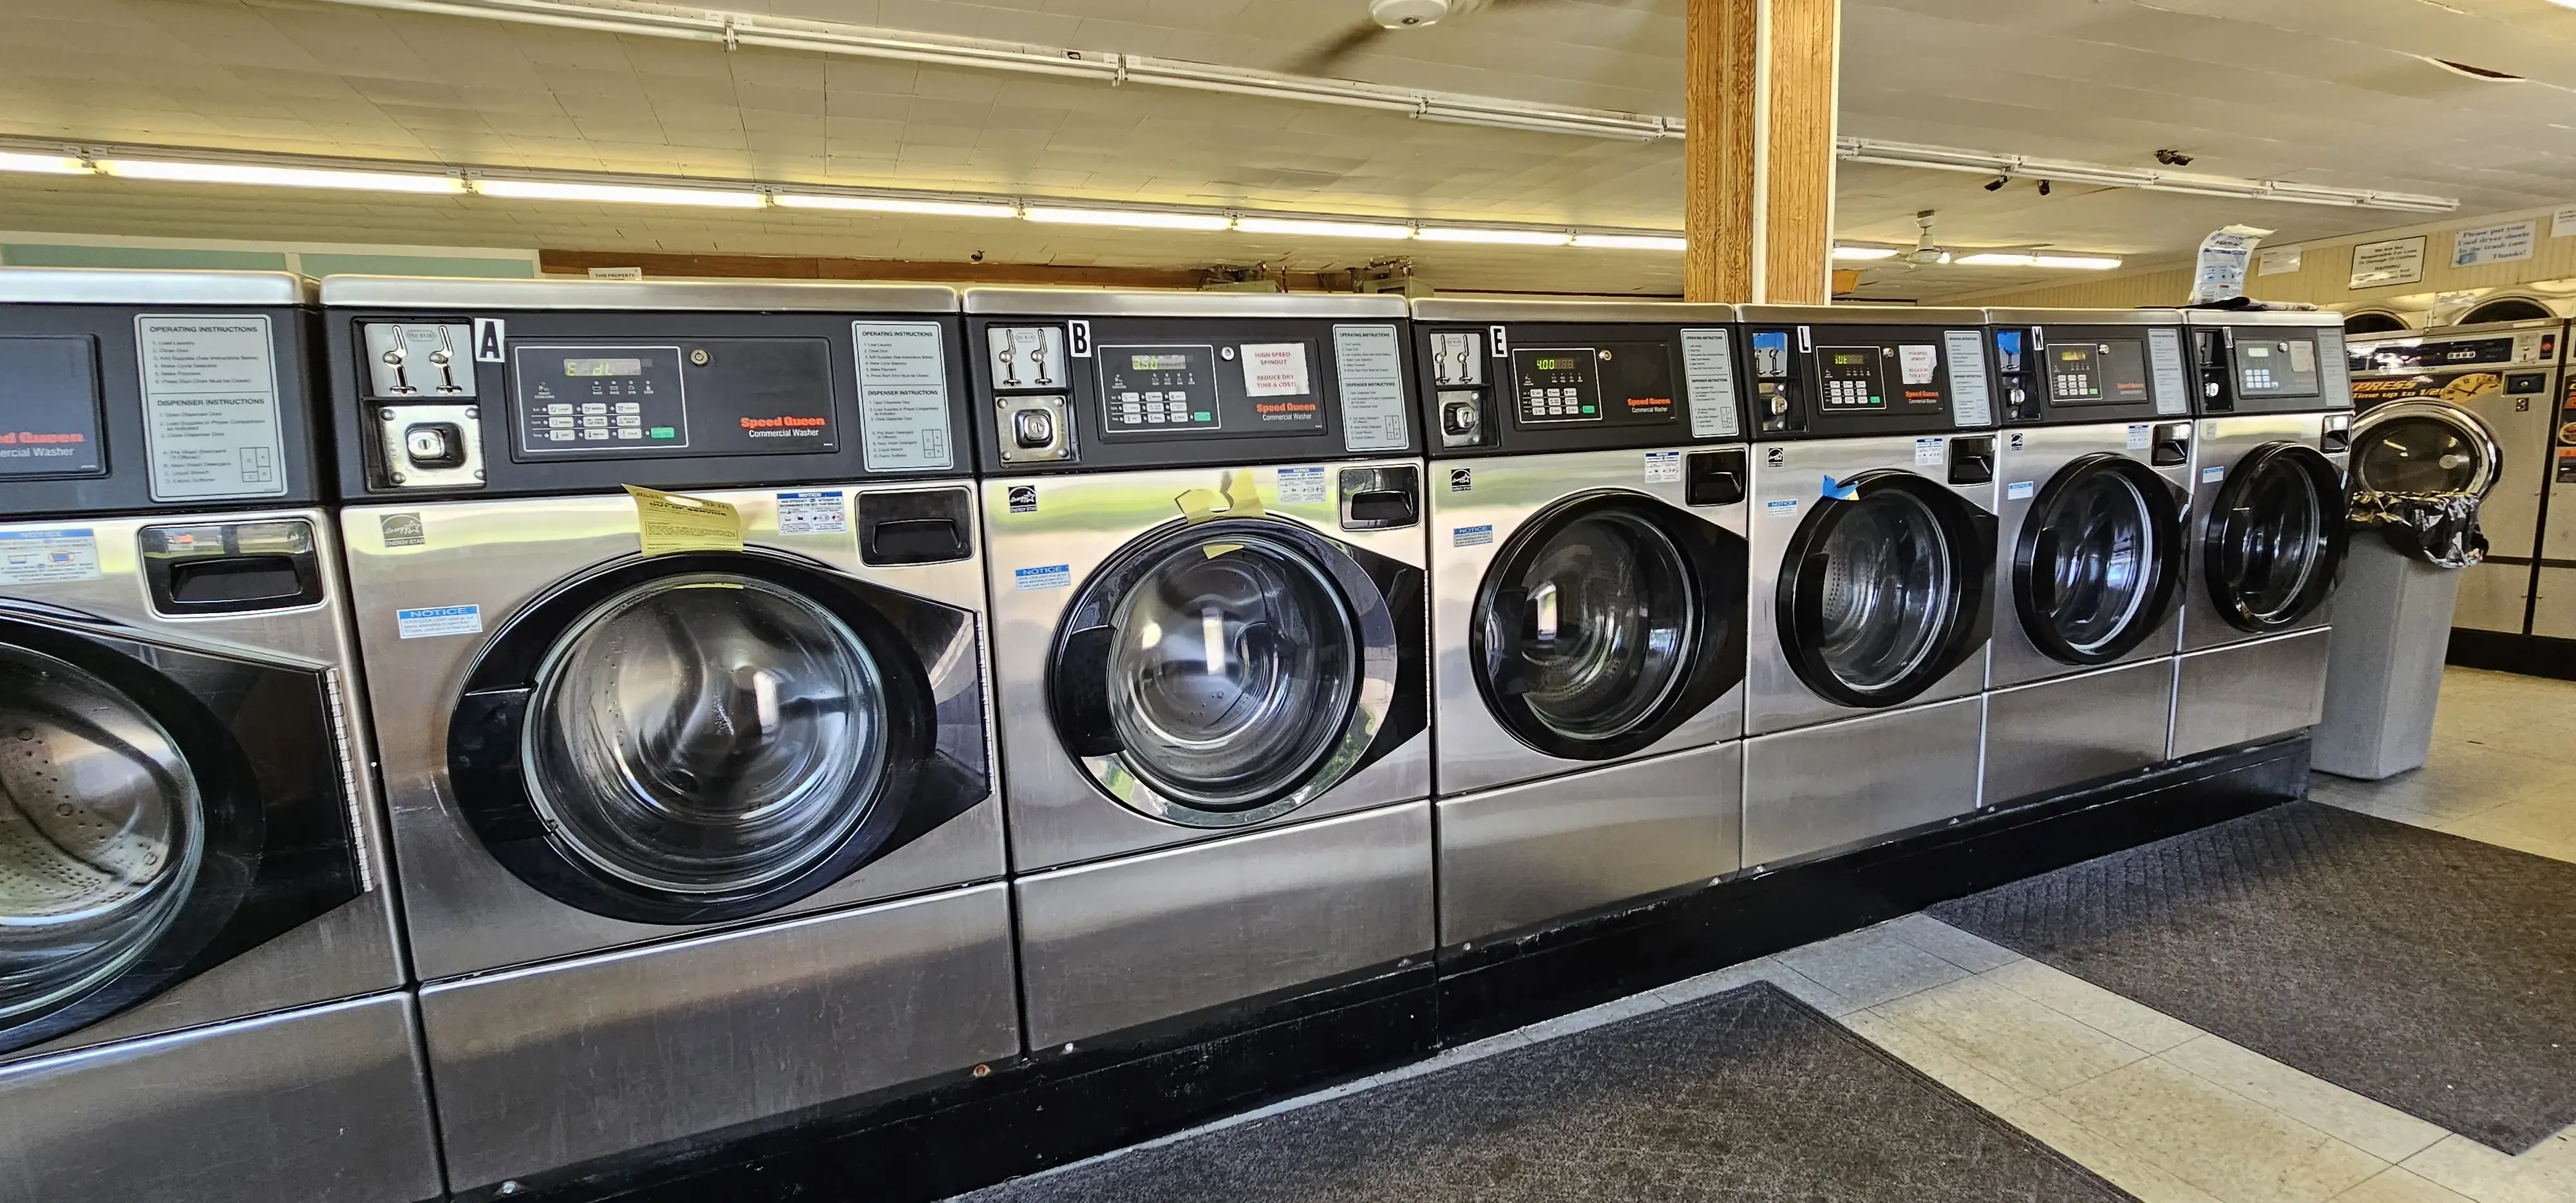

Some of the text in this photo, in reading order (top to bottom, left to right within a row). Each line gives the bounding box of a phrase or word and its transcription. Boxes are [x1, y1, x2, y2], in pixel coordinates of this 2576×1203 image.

[479, 321, 500, 359] A
[1072, 323, 1087, 354] B
[1493, 328, 1504, 355] E
[1800, 328, 1809, 350] L
[2034, 328, 2042, 348] M
[1256, 403, 1285, 413] Speed
[1627, 398, 1649, 406] Speed
[2517, 398, 2528, 412] 3
[741, 416, 825, 428] Speed Queen
[19, 432, 85, 444] Queen
[33, 448, 75, 457] Washer
[410, 607, 467, 618] NOTICE
